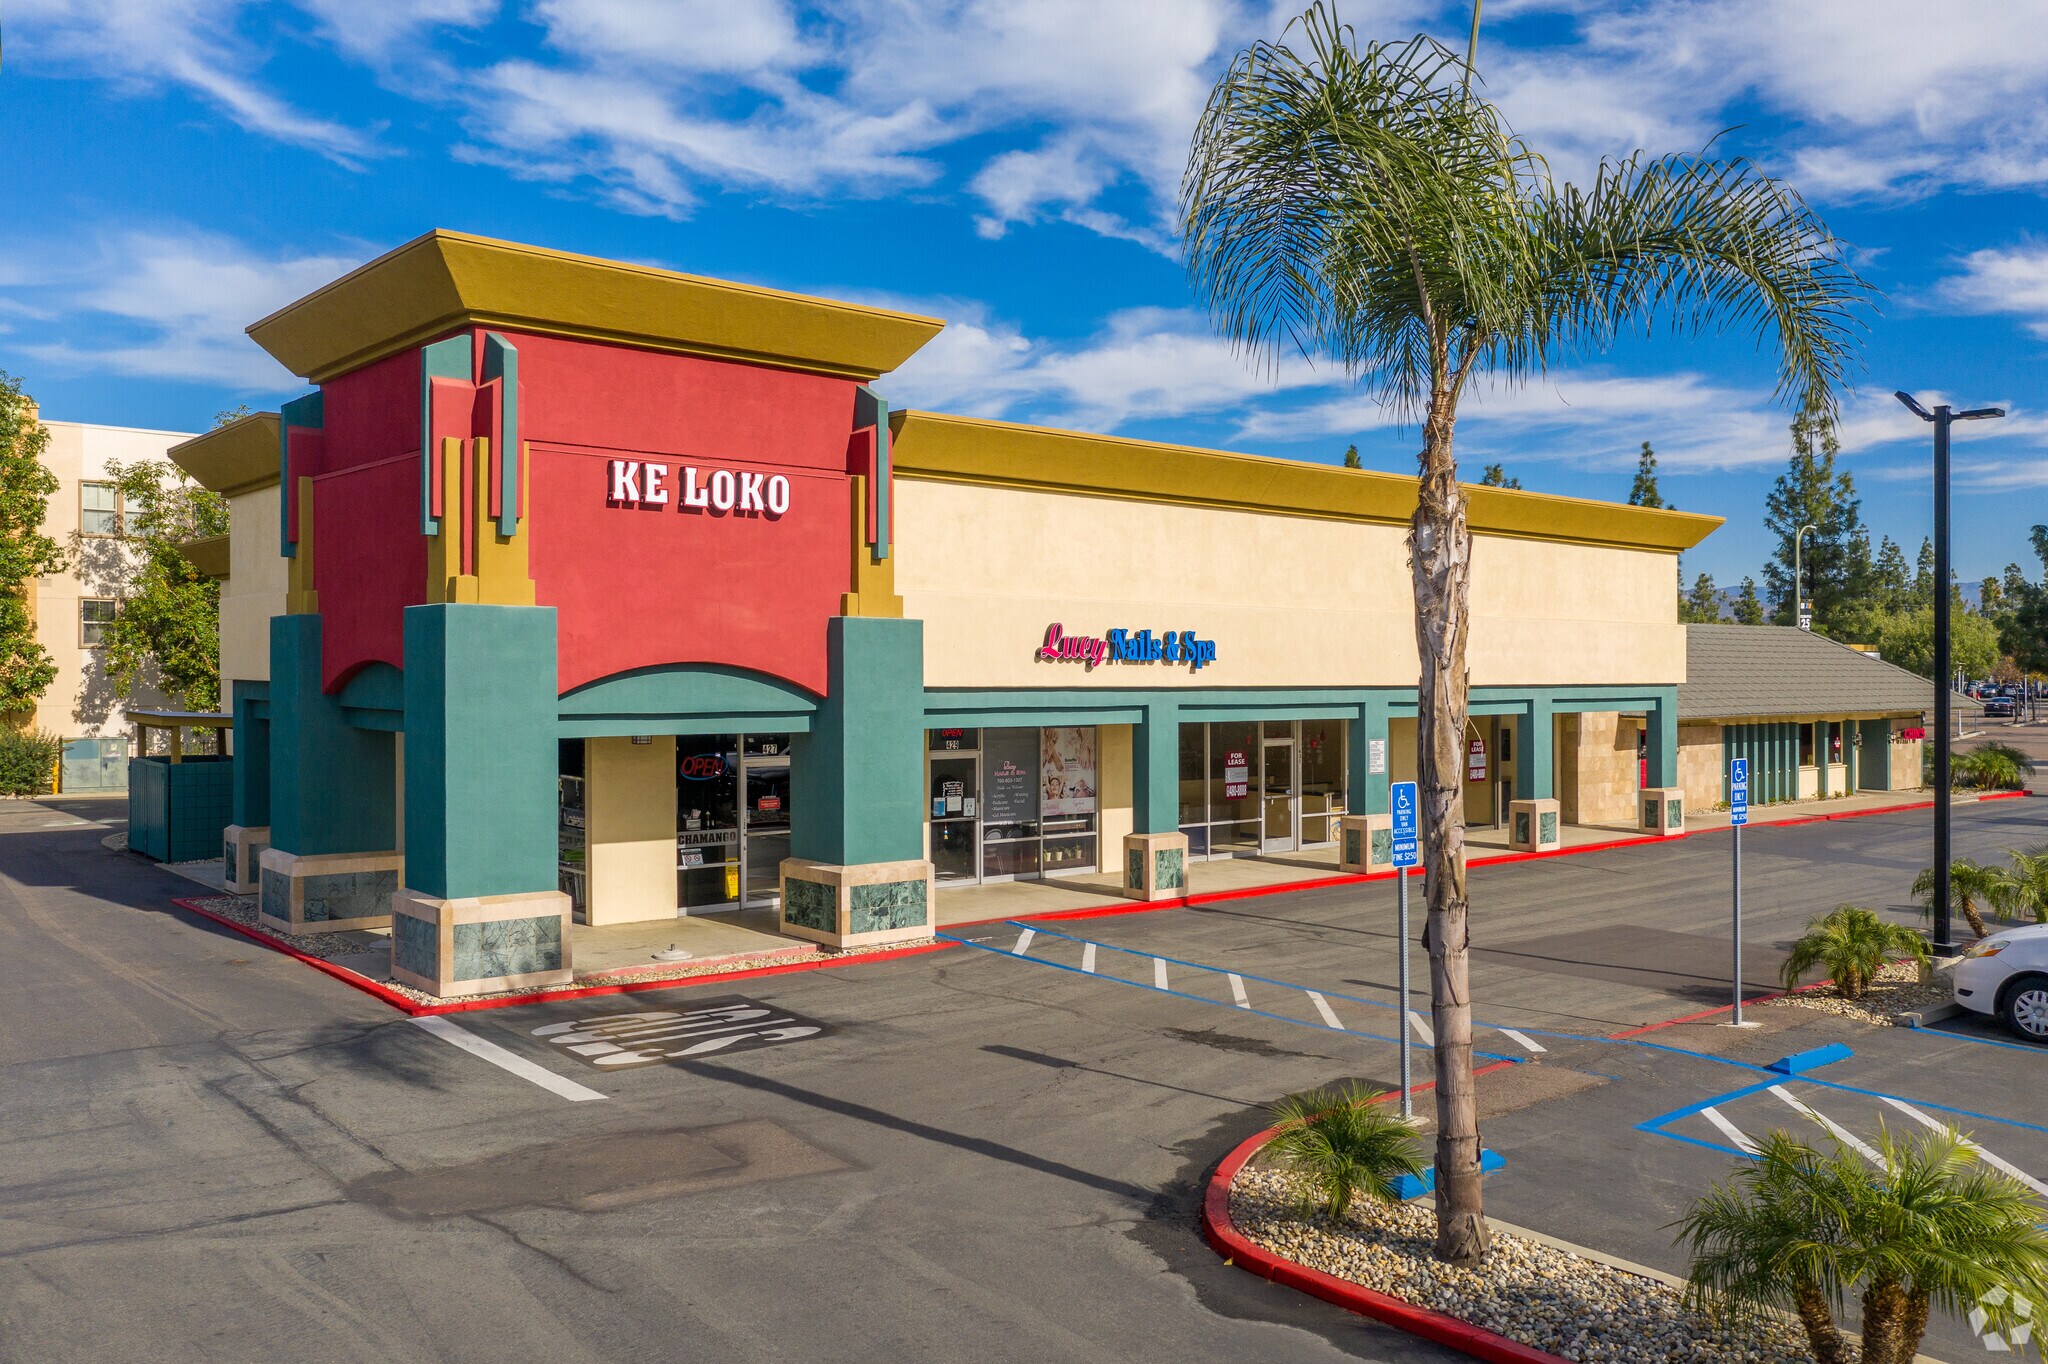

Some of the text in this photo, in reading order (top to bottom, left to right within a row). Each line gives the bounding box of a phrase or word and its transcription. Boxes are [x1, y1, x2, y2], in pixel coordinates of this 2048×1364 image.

[610, 459, 790, 514] KE LOKO
[1041, 622, 1217, 669] Lucy Nails & Spa
[942, 728, 963, 737] OPEN
[763, 744, 777, 754] 427
[682, 756, 724, 777] OPEN
[1394, 826, 1416, 834] ACCESSIBLE
[678, 831, 736, 845] CHAMANGO
[1395, 842, 1415, 851] MINIMUM
[1393, 851, 1416, 861] FINE $250
